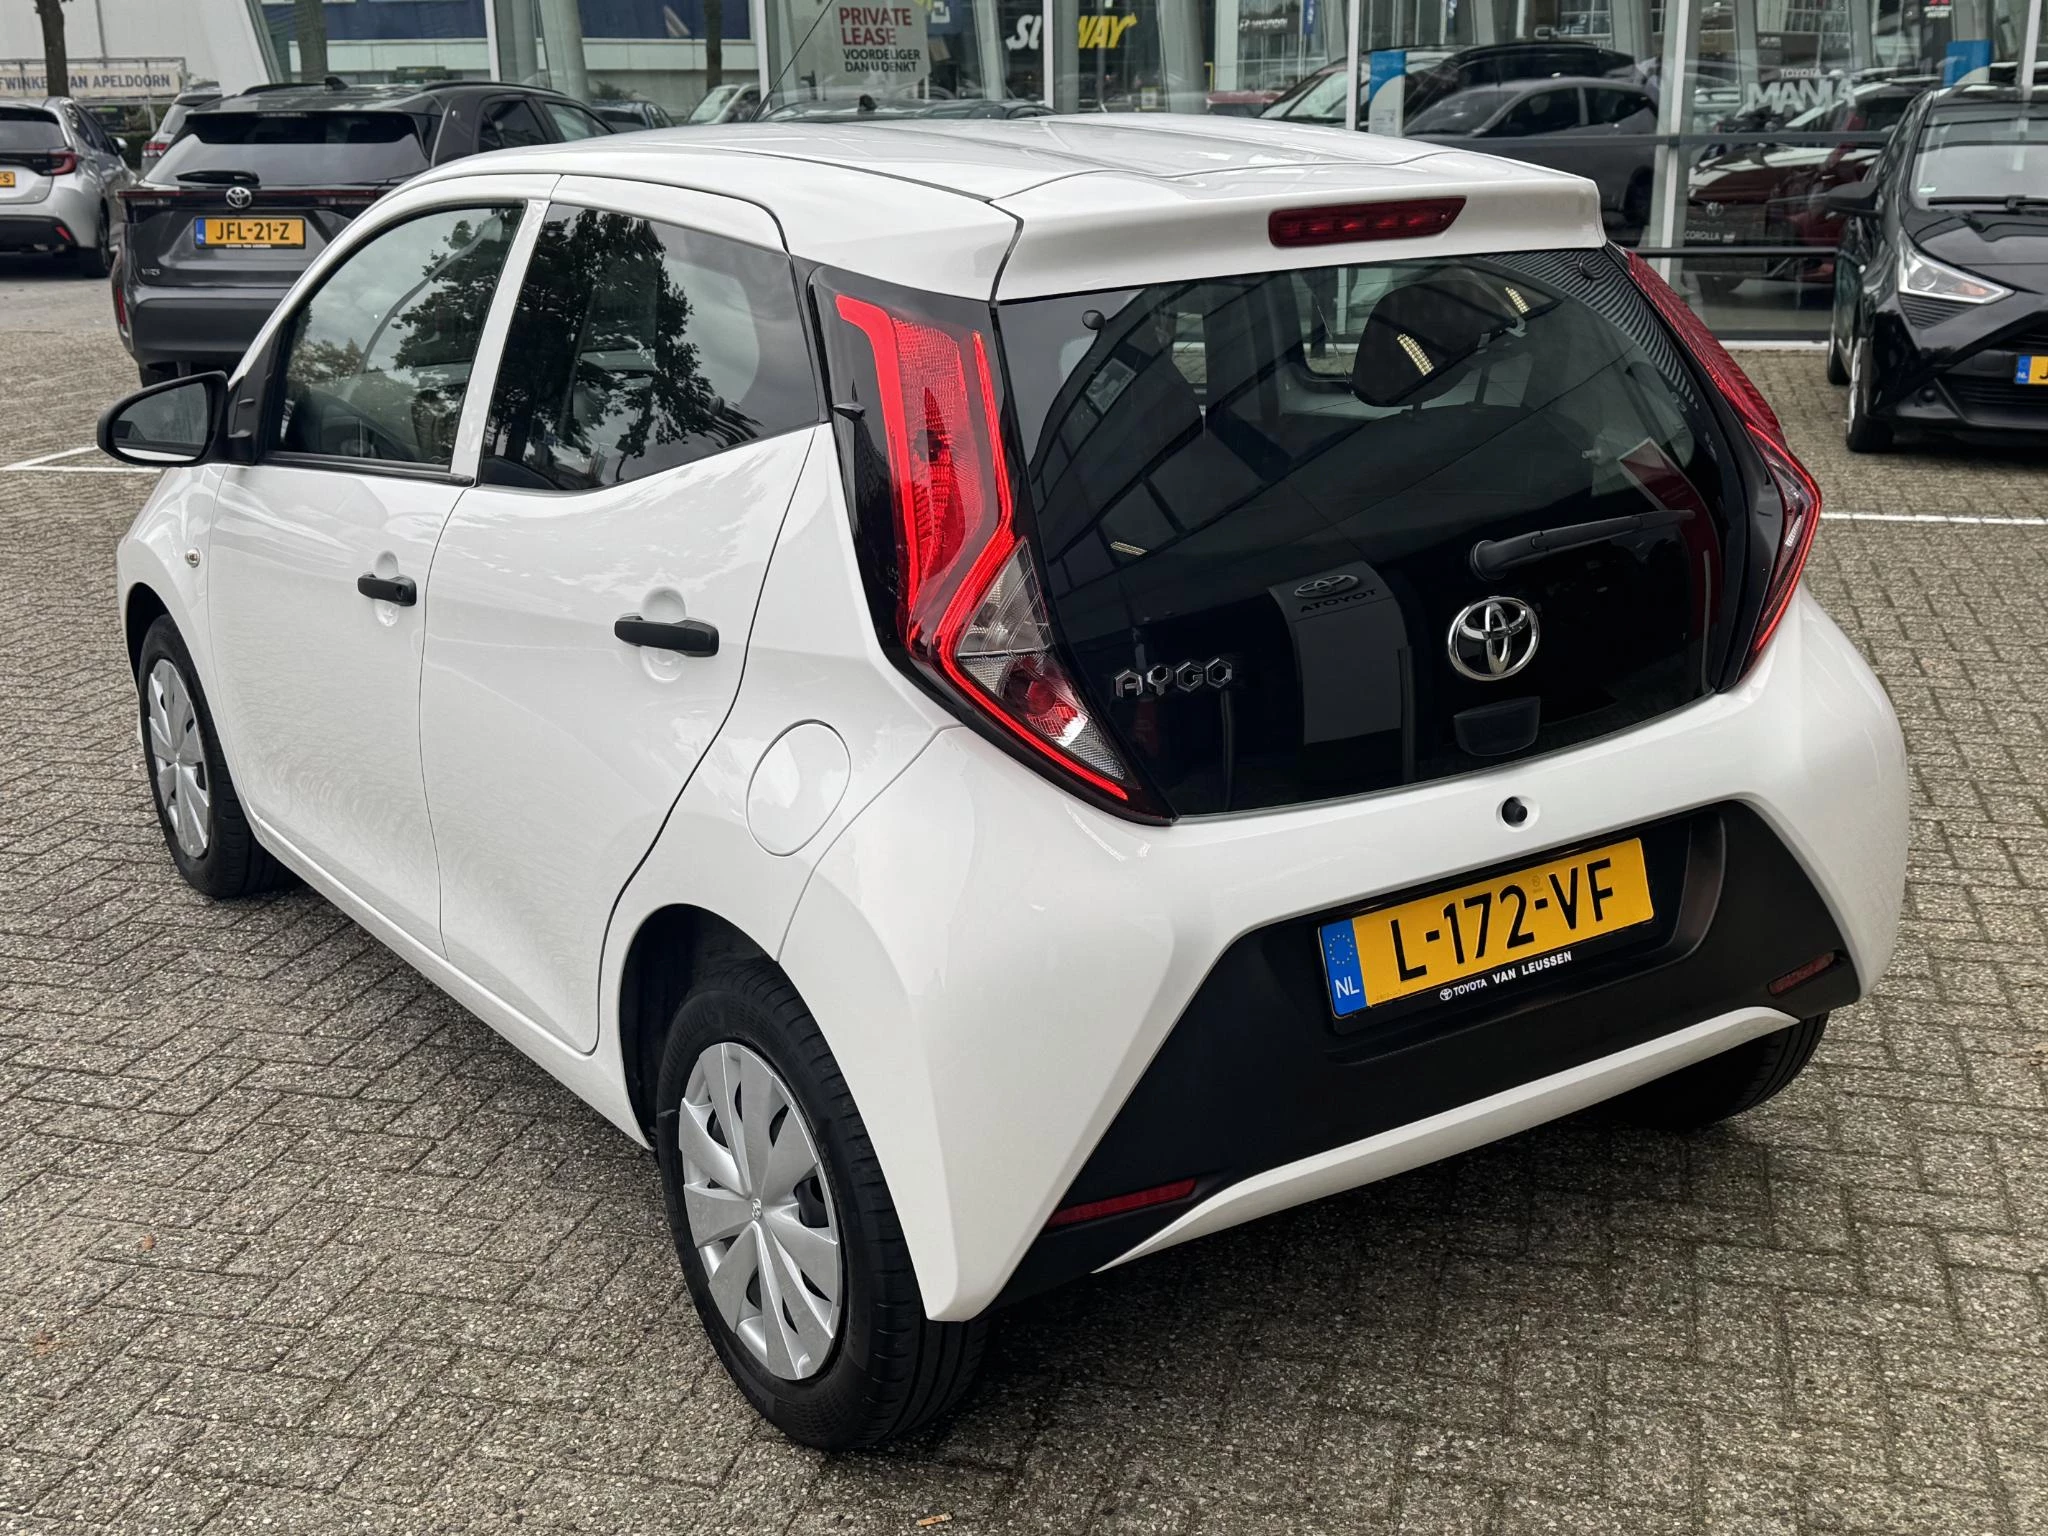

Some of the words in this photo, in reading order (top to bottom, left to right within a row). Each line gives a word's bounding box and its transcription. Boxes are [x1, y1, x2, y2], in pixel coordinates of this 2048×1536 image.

[838, 7, 912, 26] PRIVATE
[841, 27, 897, 46] LEASE
[843, 48, 921, 60] VOORDELIGER
[845, 61, 869, 73] DAN
[870, 61, 880, 72] U
[881, 61, 917, 73] DENKT
[1780, 68, 1821, 78] TOYOTA
[70, 75, 88, 88] AN
[93, 74, 170, 88] APELDOORN
[1746, 79, 1856, 114] MANIA
[215, 222, 290, 241] JFL-21-Z
[1685, 230, 1720, 240] COROLLA
[1114, 657, 1233, 698] AYGO
[1390, 858, 1614, 982] L-172-VF
[1453, 979, 1487, 996] TOYOTA
[1492, 968, 1516, 984] VAN
[1521, 951, 1572, 975] LEUSSEN
[1334, 975, 1360, 999] NL
